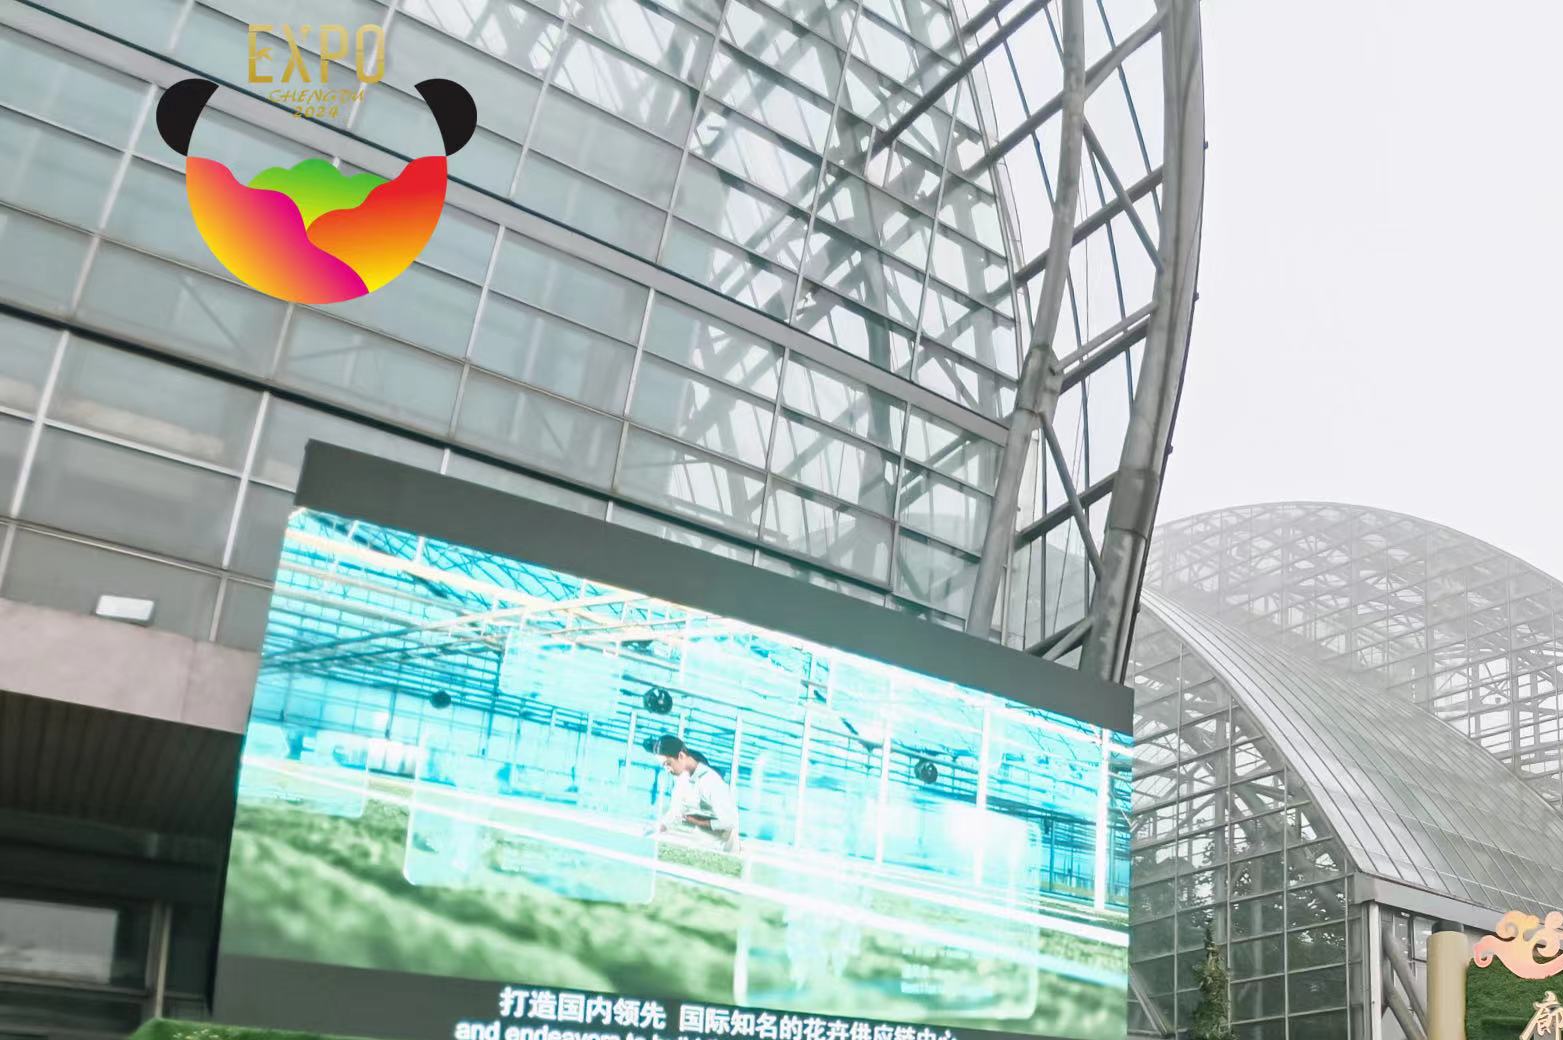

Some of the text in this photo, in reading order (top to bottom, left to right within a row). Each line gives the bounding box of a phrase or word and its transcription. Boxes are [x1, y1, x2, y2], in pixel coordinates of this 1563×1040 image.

[499, 986, 667, 1029] 打造国内领先
